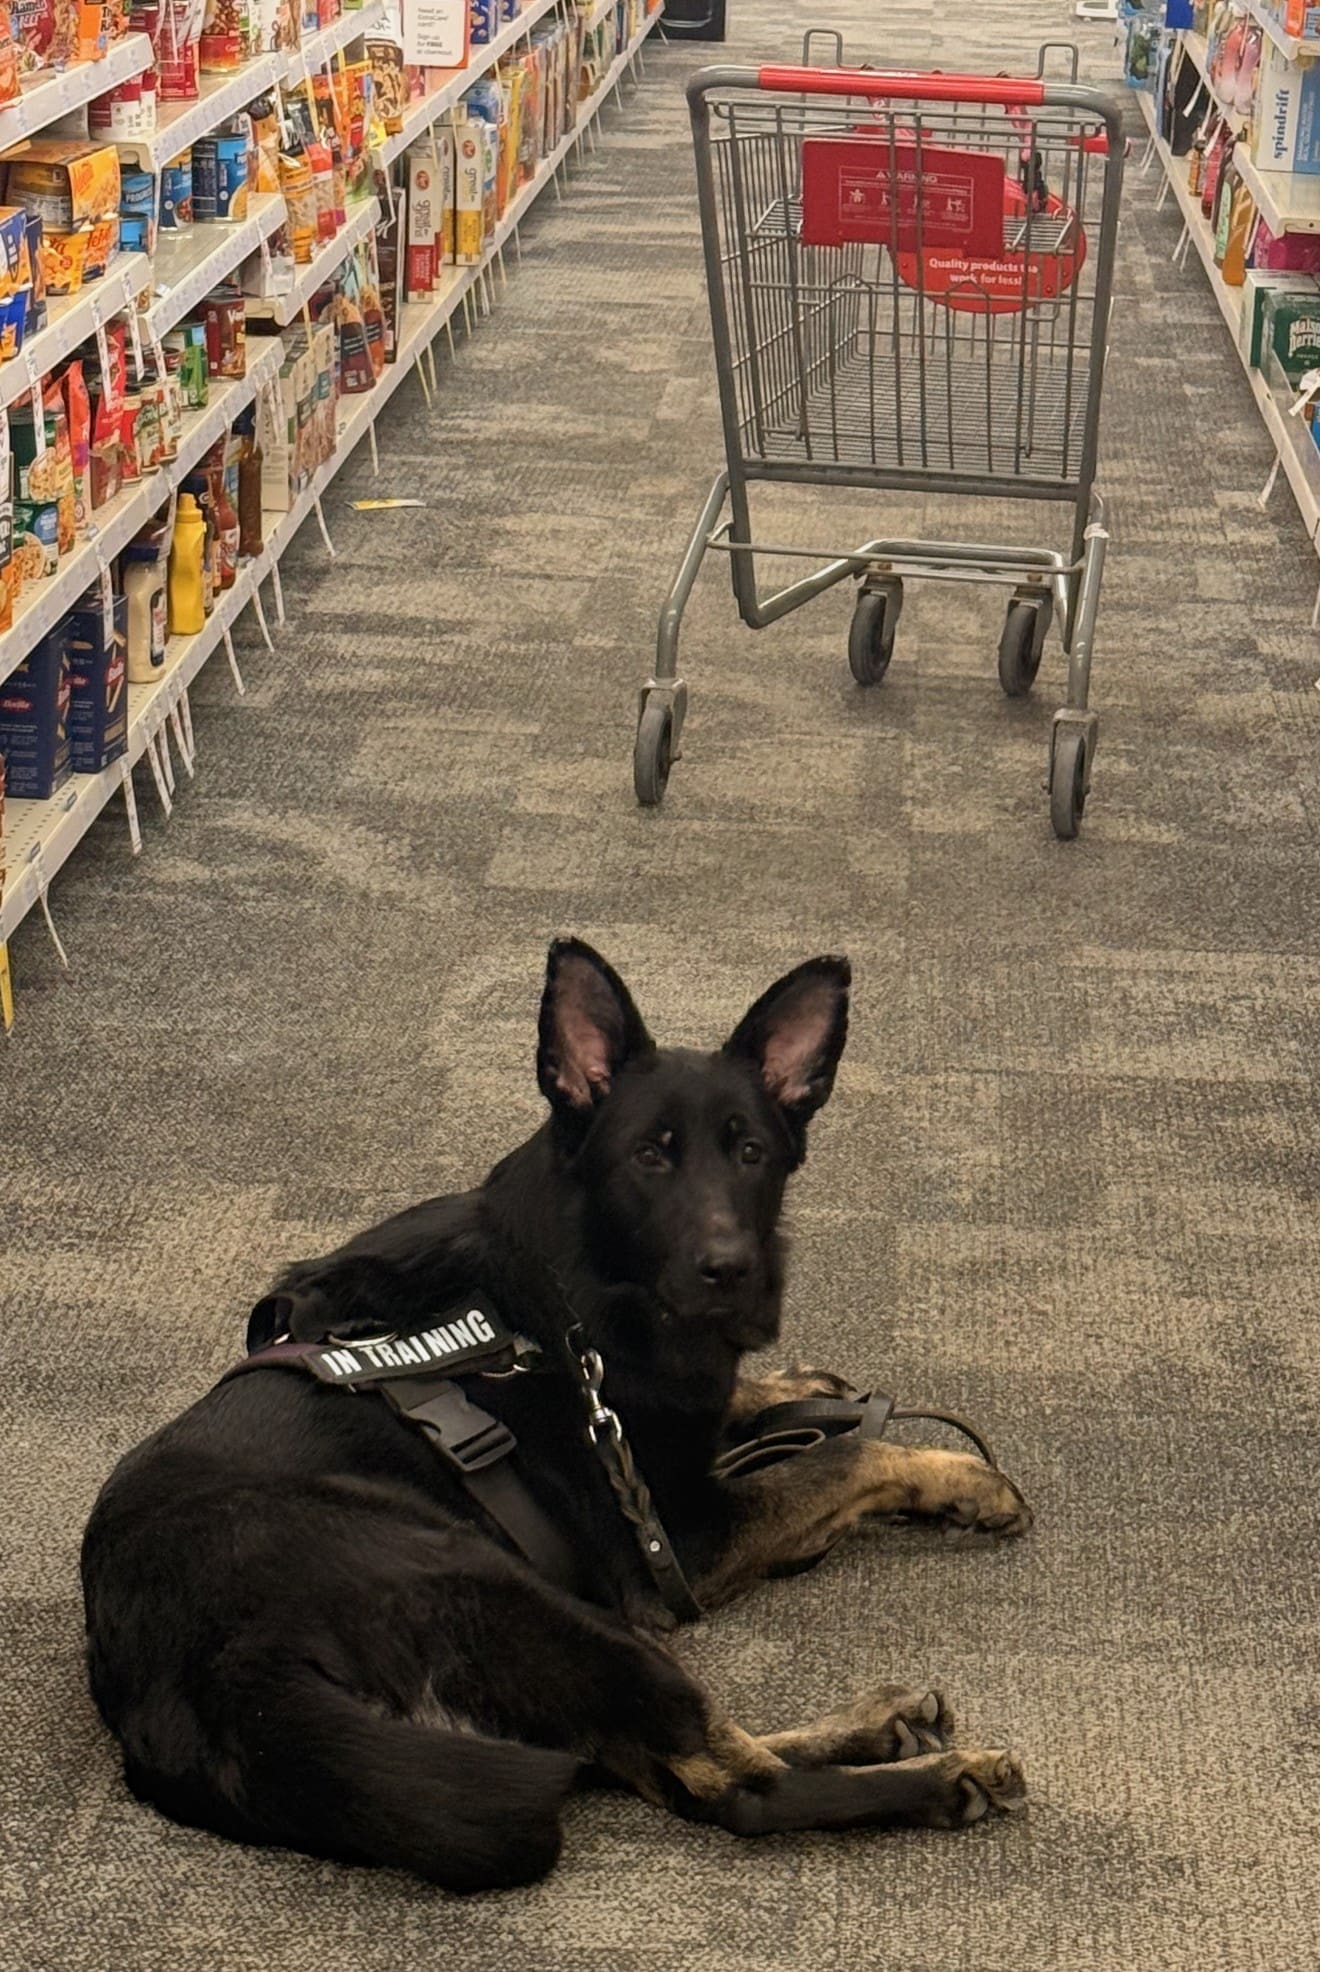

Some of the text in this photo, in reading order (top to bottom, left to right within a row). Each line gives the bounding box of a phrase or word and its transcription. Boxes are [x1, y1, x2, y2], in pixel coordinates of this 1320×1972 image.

[1272, 89, 1290, 159] spindrift
[929, 258, 969, 271] Quality
[970, 261, 1018, 273] products
[981, 273, 996, 284] for
[321, 1309, 496, 1377] IN TRAINING
